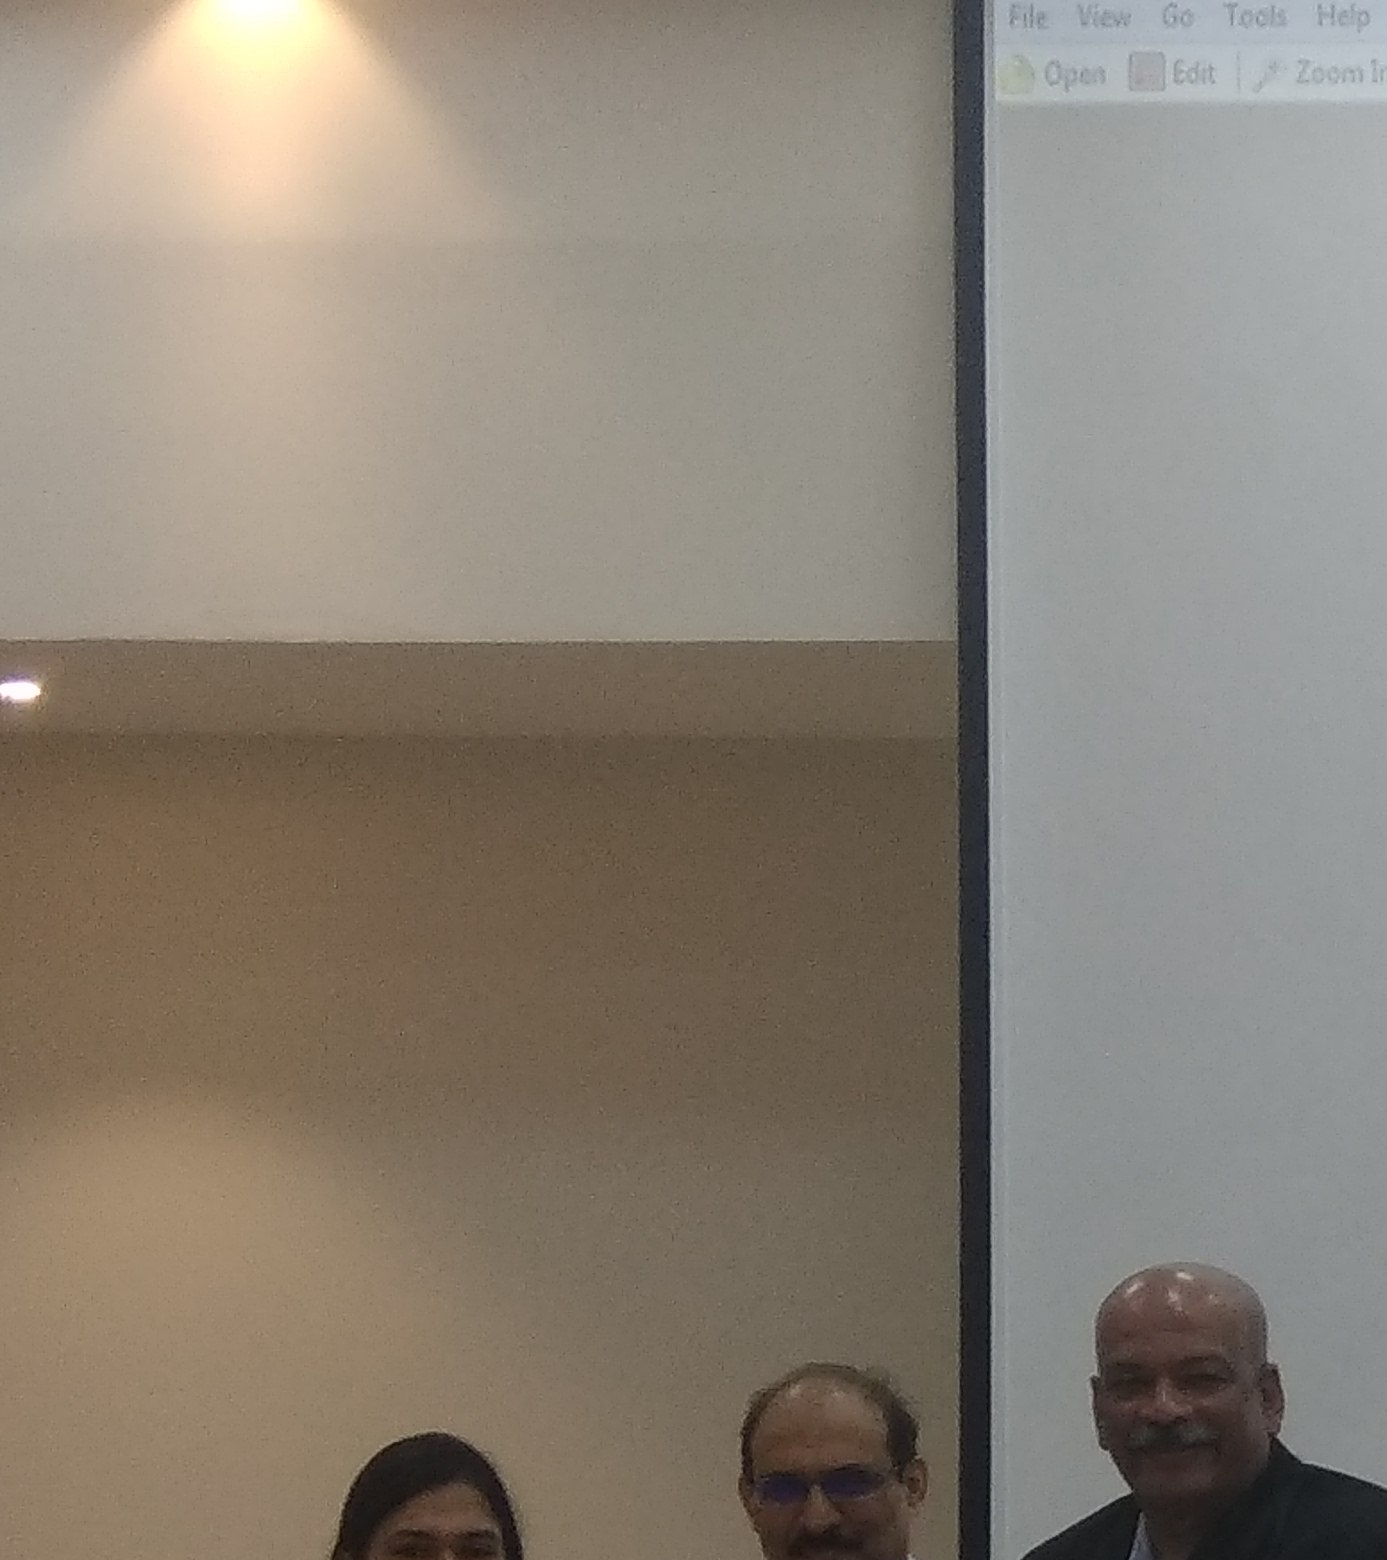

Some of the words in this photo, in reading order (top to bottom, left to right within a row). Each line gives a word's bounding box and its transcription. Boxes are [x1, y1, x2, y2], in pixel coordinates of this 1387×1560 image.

[1008, 5, 1049, 29] File
[1077, 5, 1132, 28] View
[1163, 4, 1195, 29] Go
[1224, 3, 1288, 28] Tools
[1317, 3, 1371, 32] Help
[1044, 60, 1107, 88] Open
[1173, 58, 1217, 85] Edit
[1296, 59, 1362, 84] Zoom
